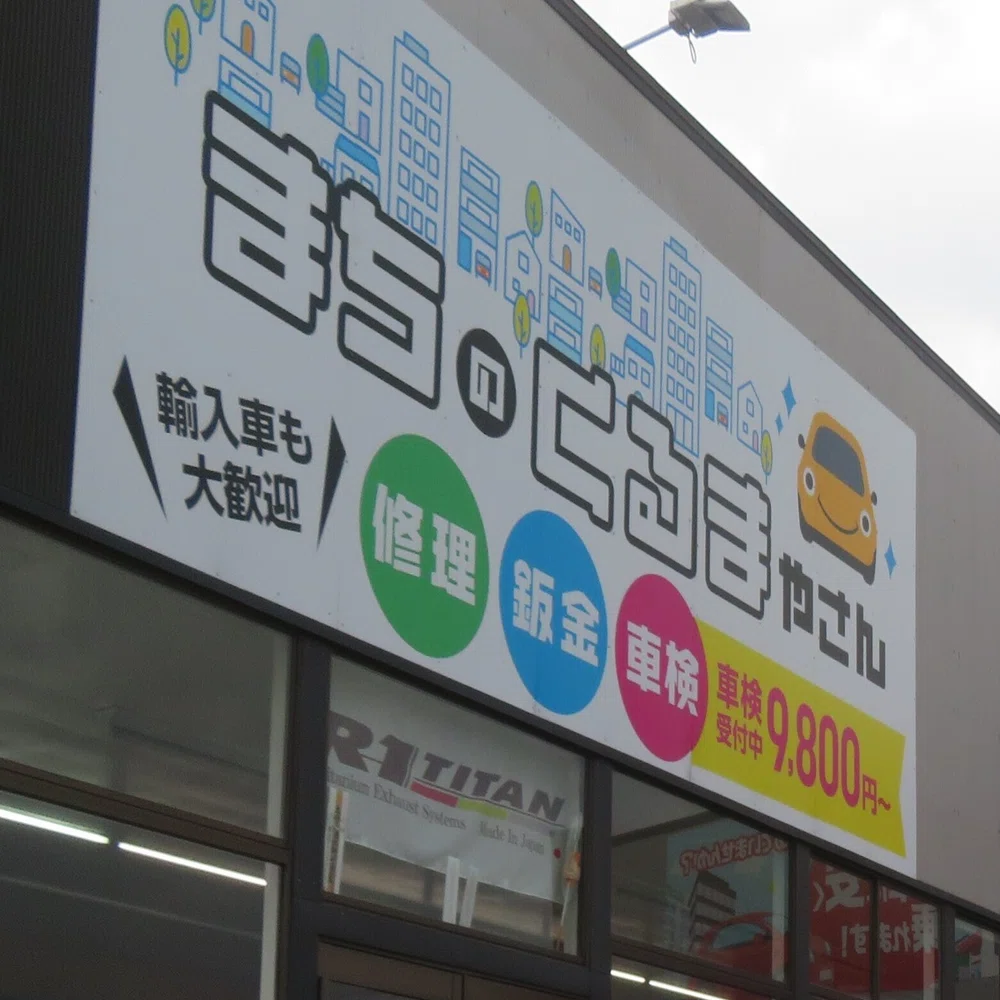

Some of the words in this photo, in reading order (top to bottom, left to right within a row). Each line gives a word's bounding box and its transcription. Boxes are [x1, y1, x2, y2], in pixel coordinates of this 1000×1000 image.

[156, 372, 313, 465] 輸入車も
[182, 454, 302, 534] 大歓迎
[372, 483, 476, 607] 修理
[512, 558, 600, 667] 鈑金
[626, 622, 700, 717] 車検
[716, 662, 762, 723] 車検
[716, 712, 763, 761] 受付中
[421, 752, 566, 821] TITAN
